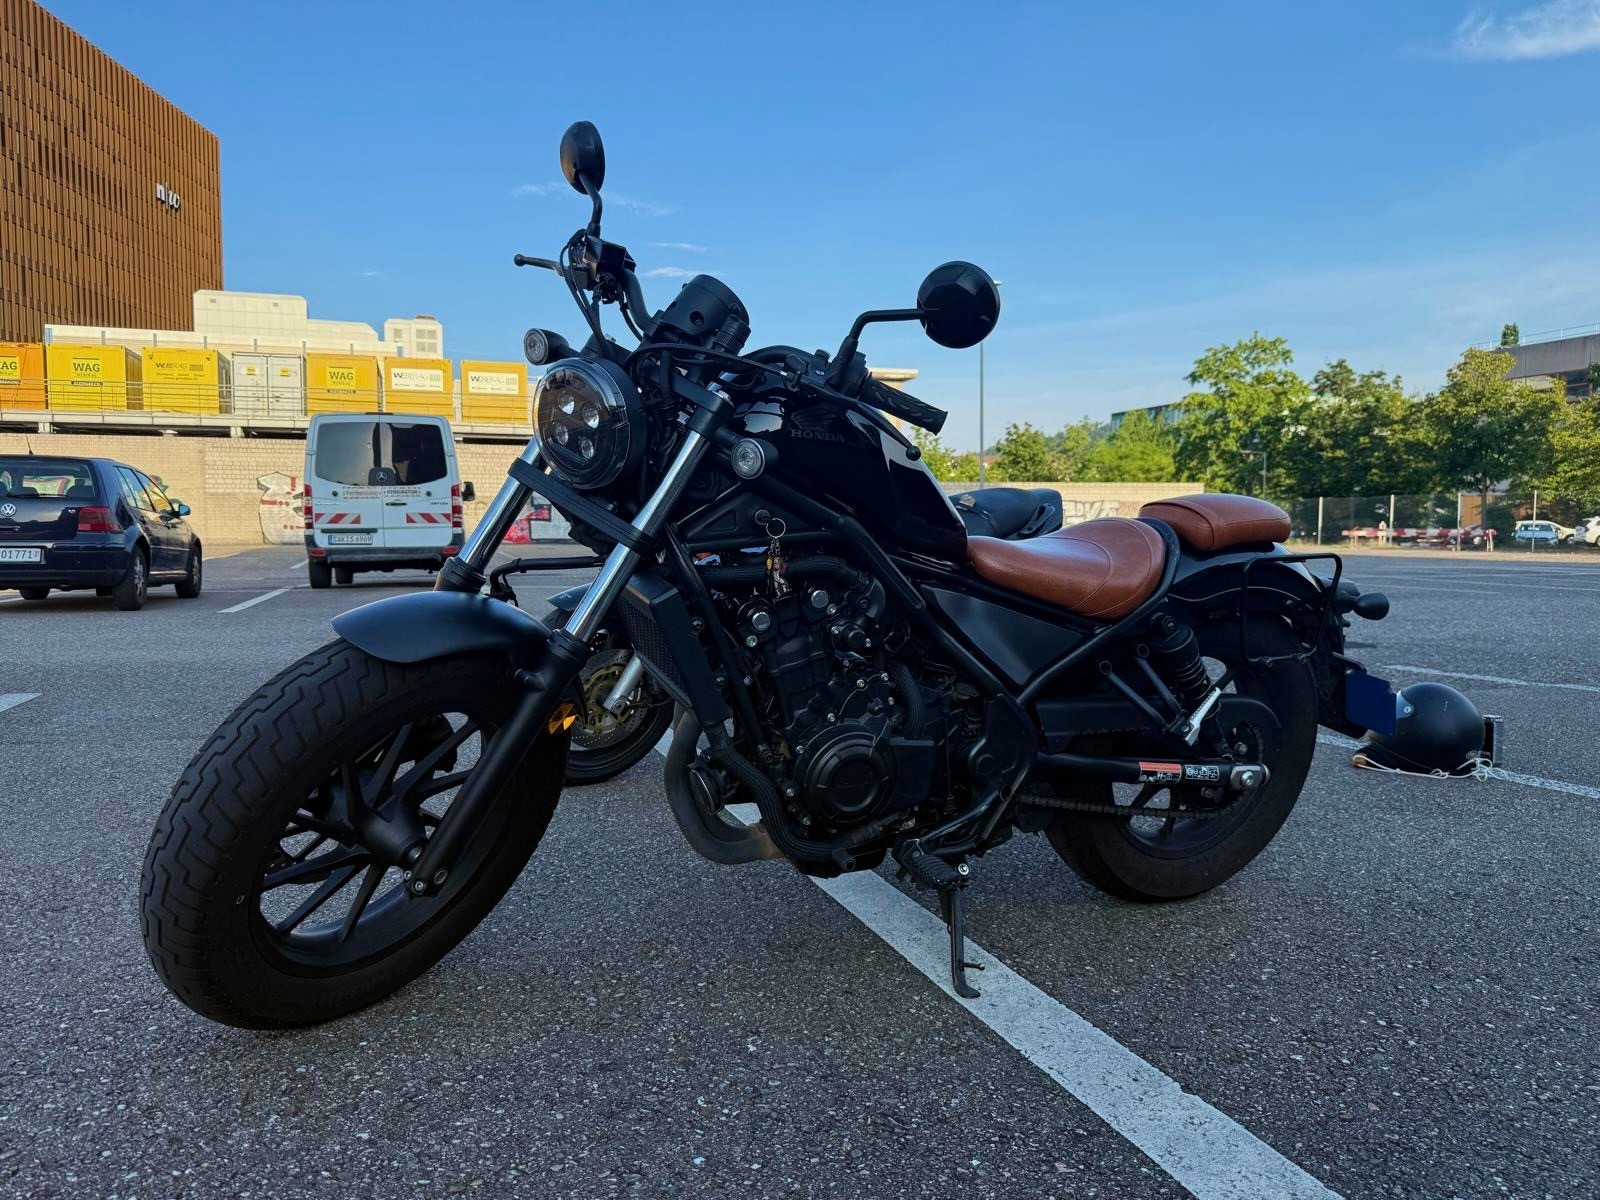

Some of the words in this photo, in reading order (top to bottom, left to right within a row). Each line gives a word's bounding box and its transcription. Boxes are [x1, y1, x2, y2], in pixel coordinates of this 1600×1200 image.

[0, 361, 17, 370] AG
[73, 363, 100, 372] WAG
[329, 372, 354, 381] WAG
[790, 429, 845, 442] HONDA
